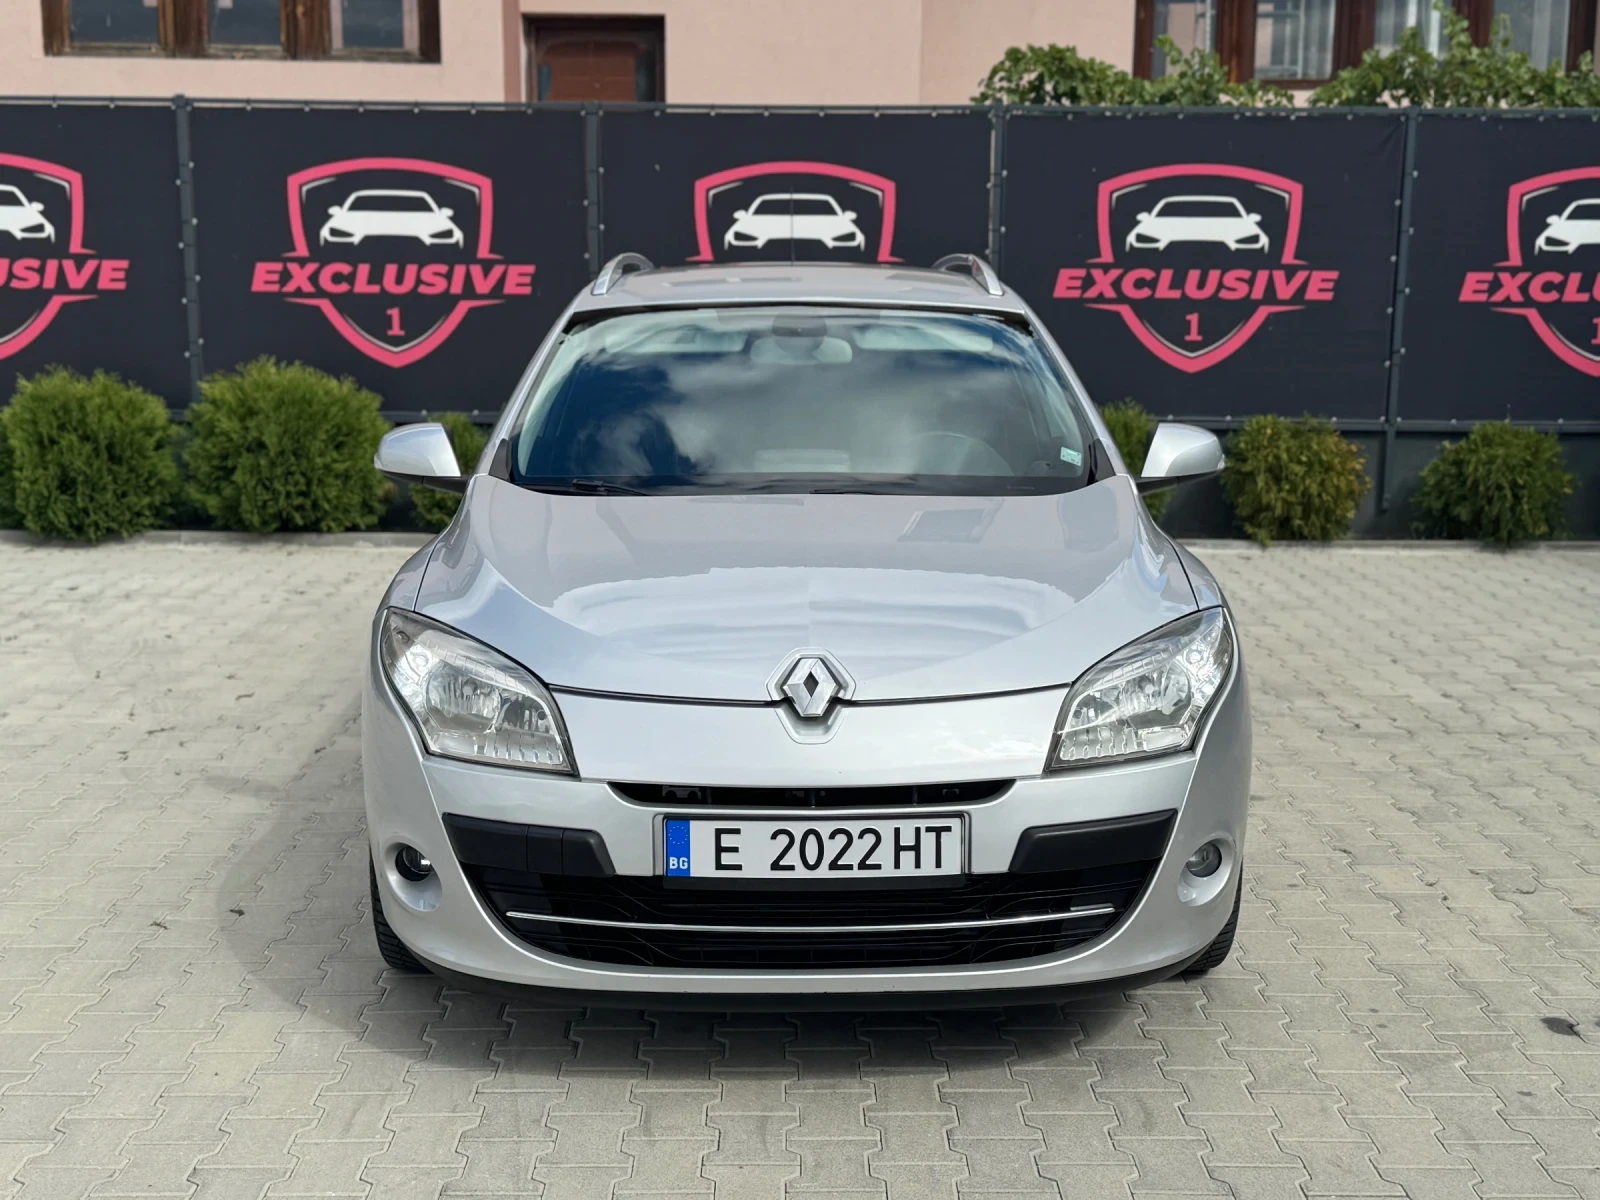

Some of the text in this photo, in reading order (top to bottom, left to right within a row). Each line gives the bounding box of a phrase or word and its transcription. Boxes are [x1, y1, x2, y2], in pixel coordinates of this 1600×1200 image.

[0, 258, 130, 290] SIVE
[251, 262, 536, 296] EXCLUSIVE
[1053, 268, 1339, 301] EXCLUSIVE
[1459, 271, 1600, 303] EXCL
[386, 307, 404, 336] 1
[1184, 313, 1203, 342] 1
[669, 856, 688, 870] BG
[714, 828, 743, 871] E
